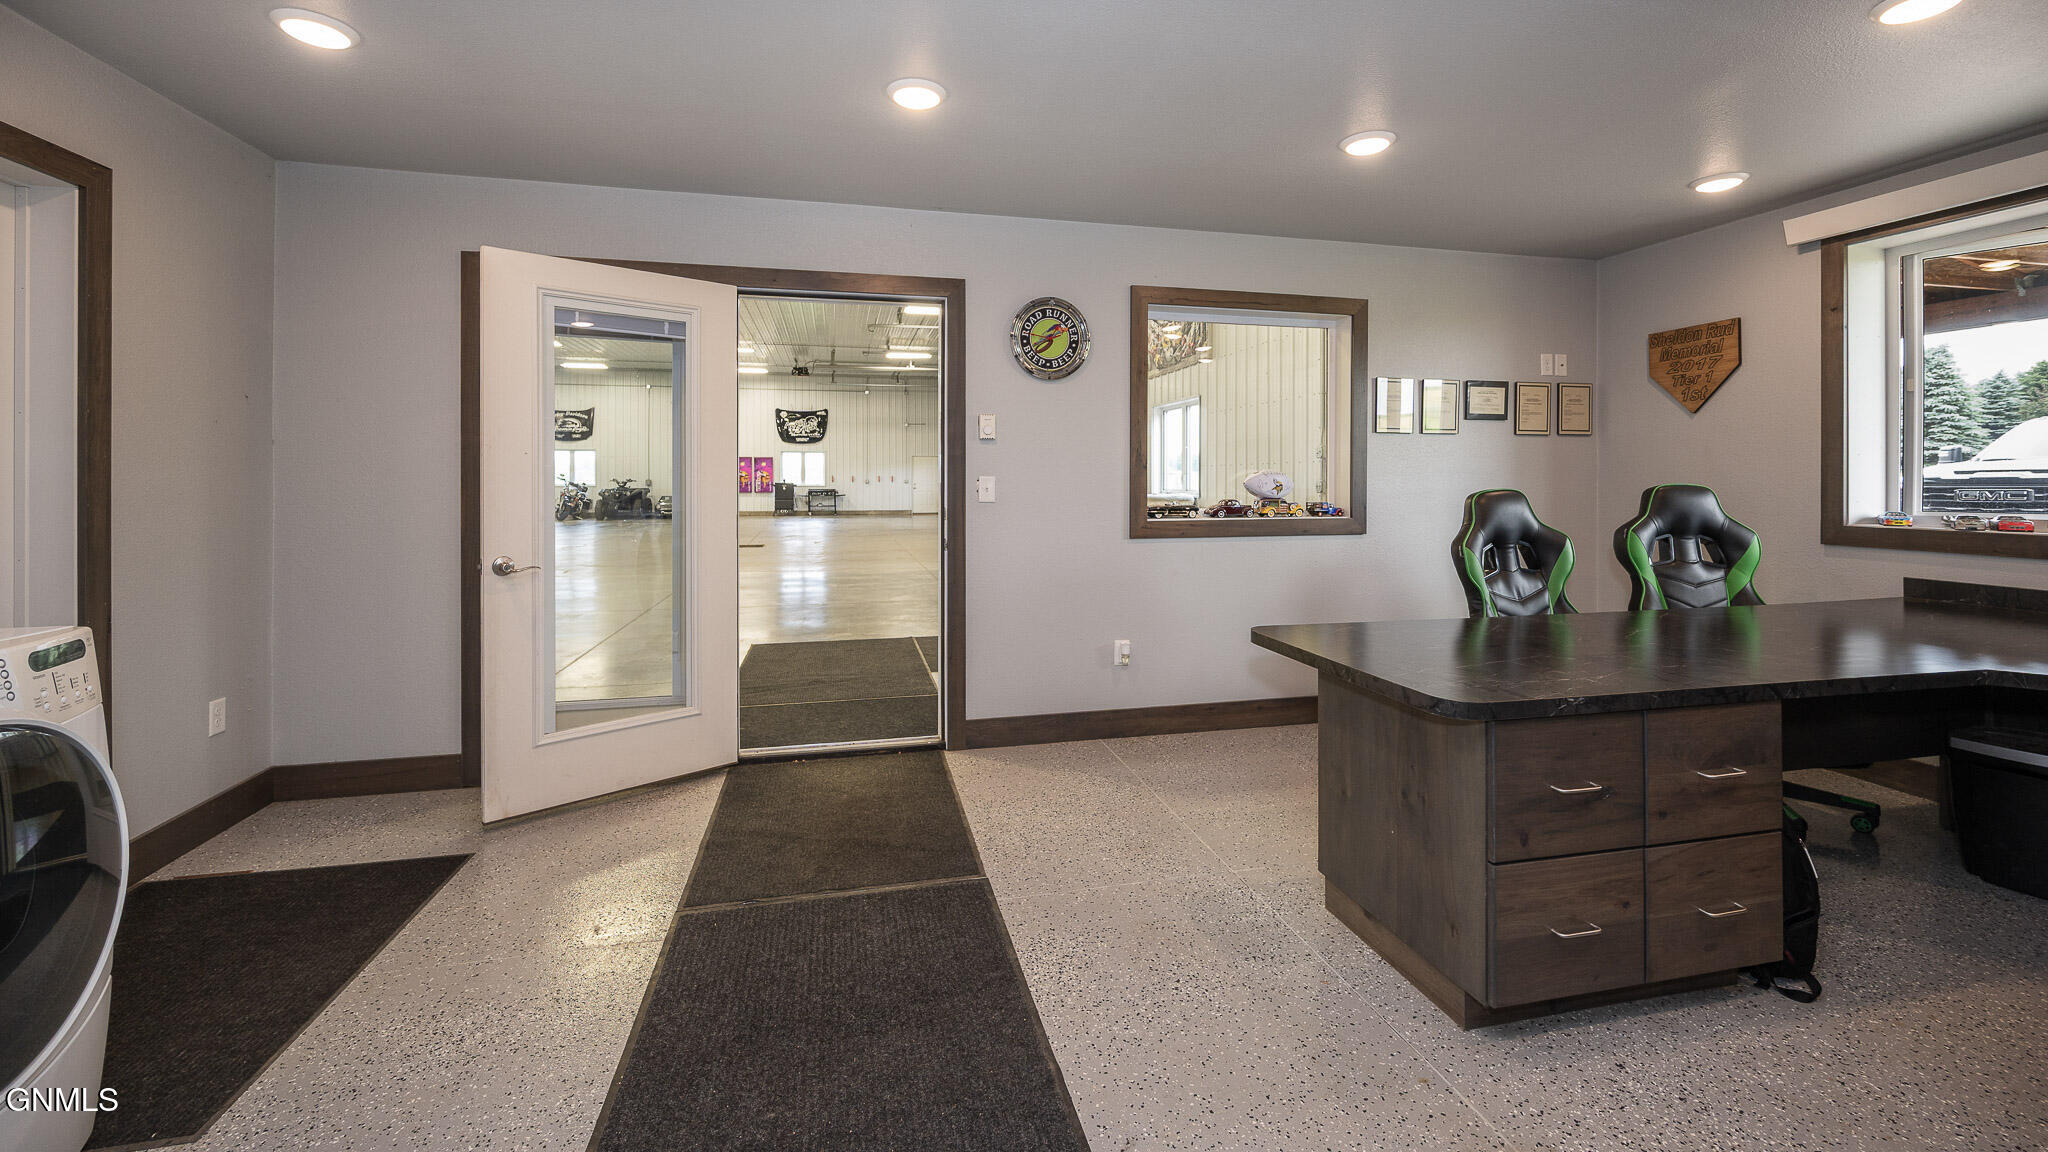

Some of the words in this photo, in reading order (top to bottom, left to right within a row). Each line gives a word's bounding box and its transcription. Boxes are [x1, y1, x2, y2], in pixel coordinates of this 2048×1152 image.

[1022, 311, 1042, 337] ROAD
[1046, 309, 1078, 341] RUNNER
[1650, 328, 1702, 348] Sheldon
[1023, 345, 1046, 366] BEEP
[1051, 349, 1074, 368] BEEP
[1659, 338, 1724, 362] Memorial
[1666, 355, 1724, 375] 2017
[1671, 373, 1701, 387] Tier
[1705, 370, 1714, 383] 1
[1681, 385, 1709, 402] 1st
[1958, 490, 2028, 501] GMC
